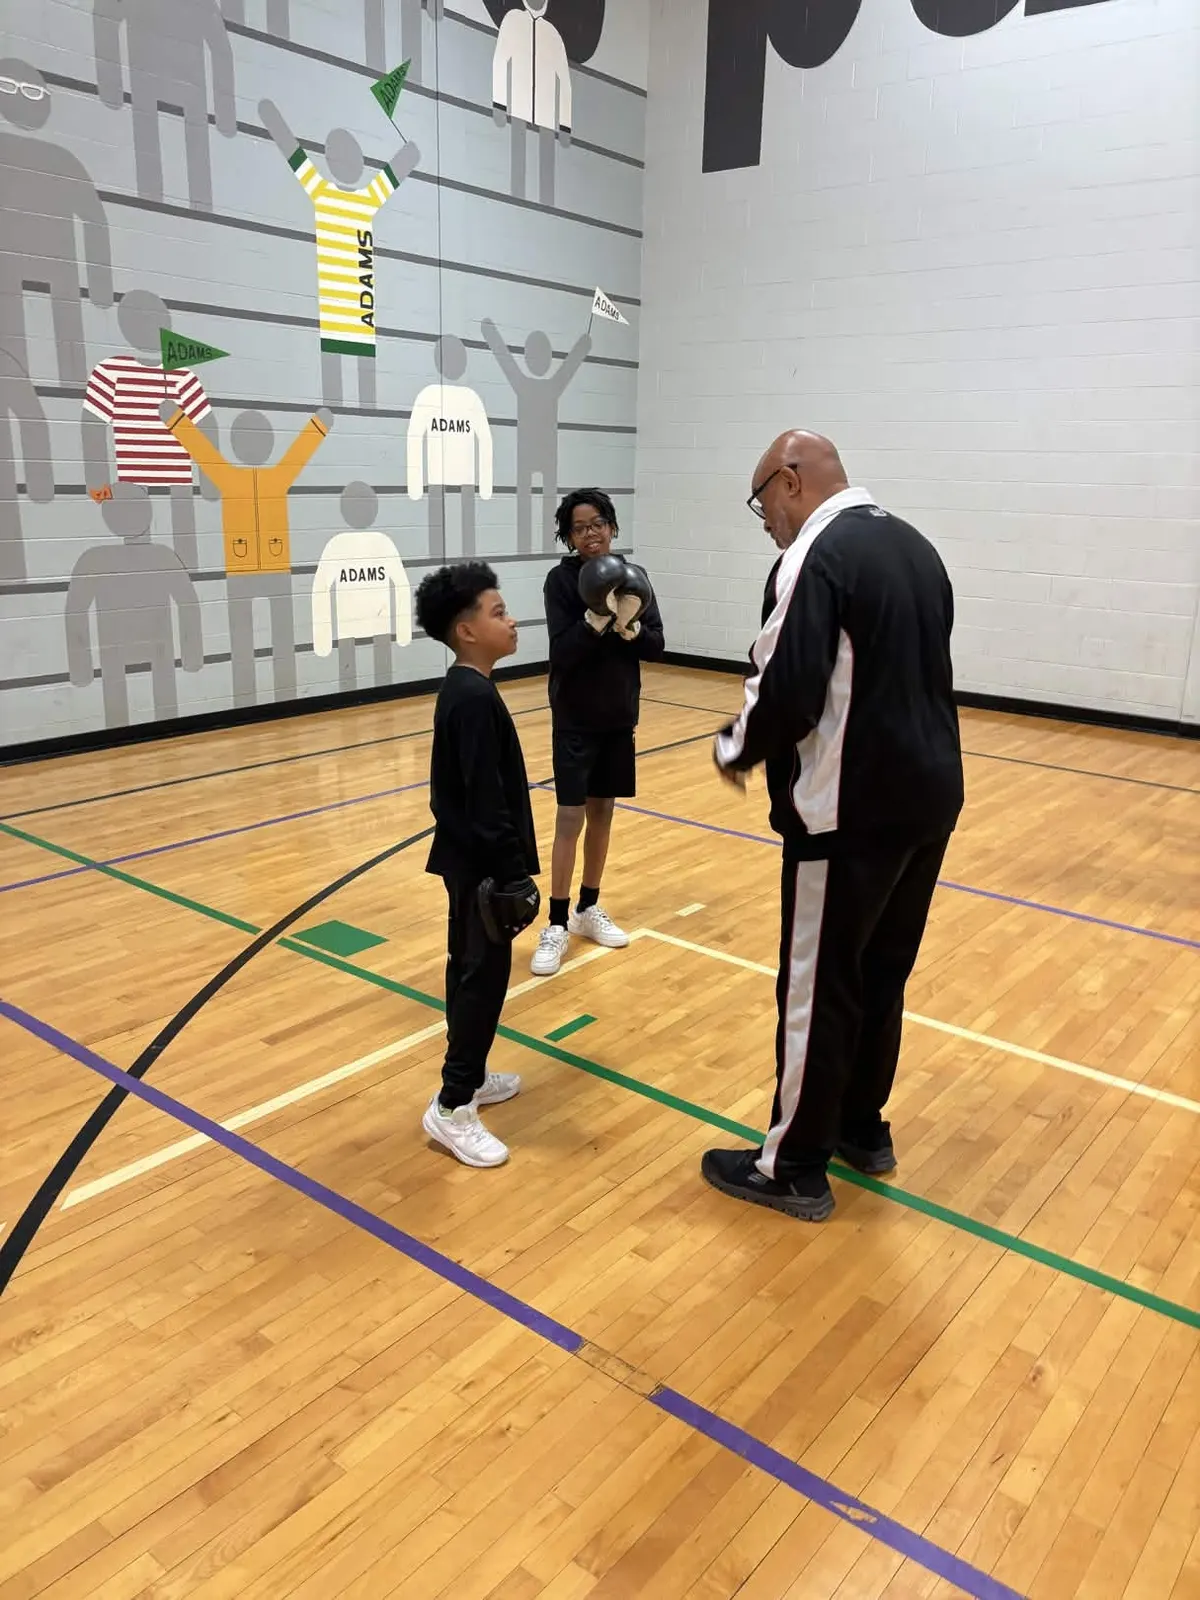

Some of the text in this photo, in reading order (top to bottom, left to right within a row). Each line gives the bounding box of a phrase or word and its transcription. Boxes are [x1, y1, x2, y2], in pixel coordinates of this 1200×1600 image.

[357, 229, 375, 328] ADAMS
[594, 296, 620, 321] ADAMS
[167, 341, 212, 363] ADAMS
[431, 417, 471, 433] ADAMS
[340, 566, 386, 582] ADAMS
